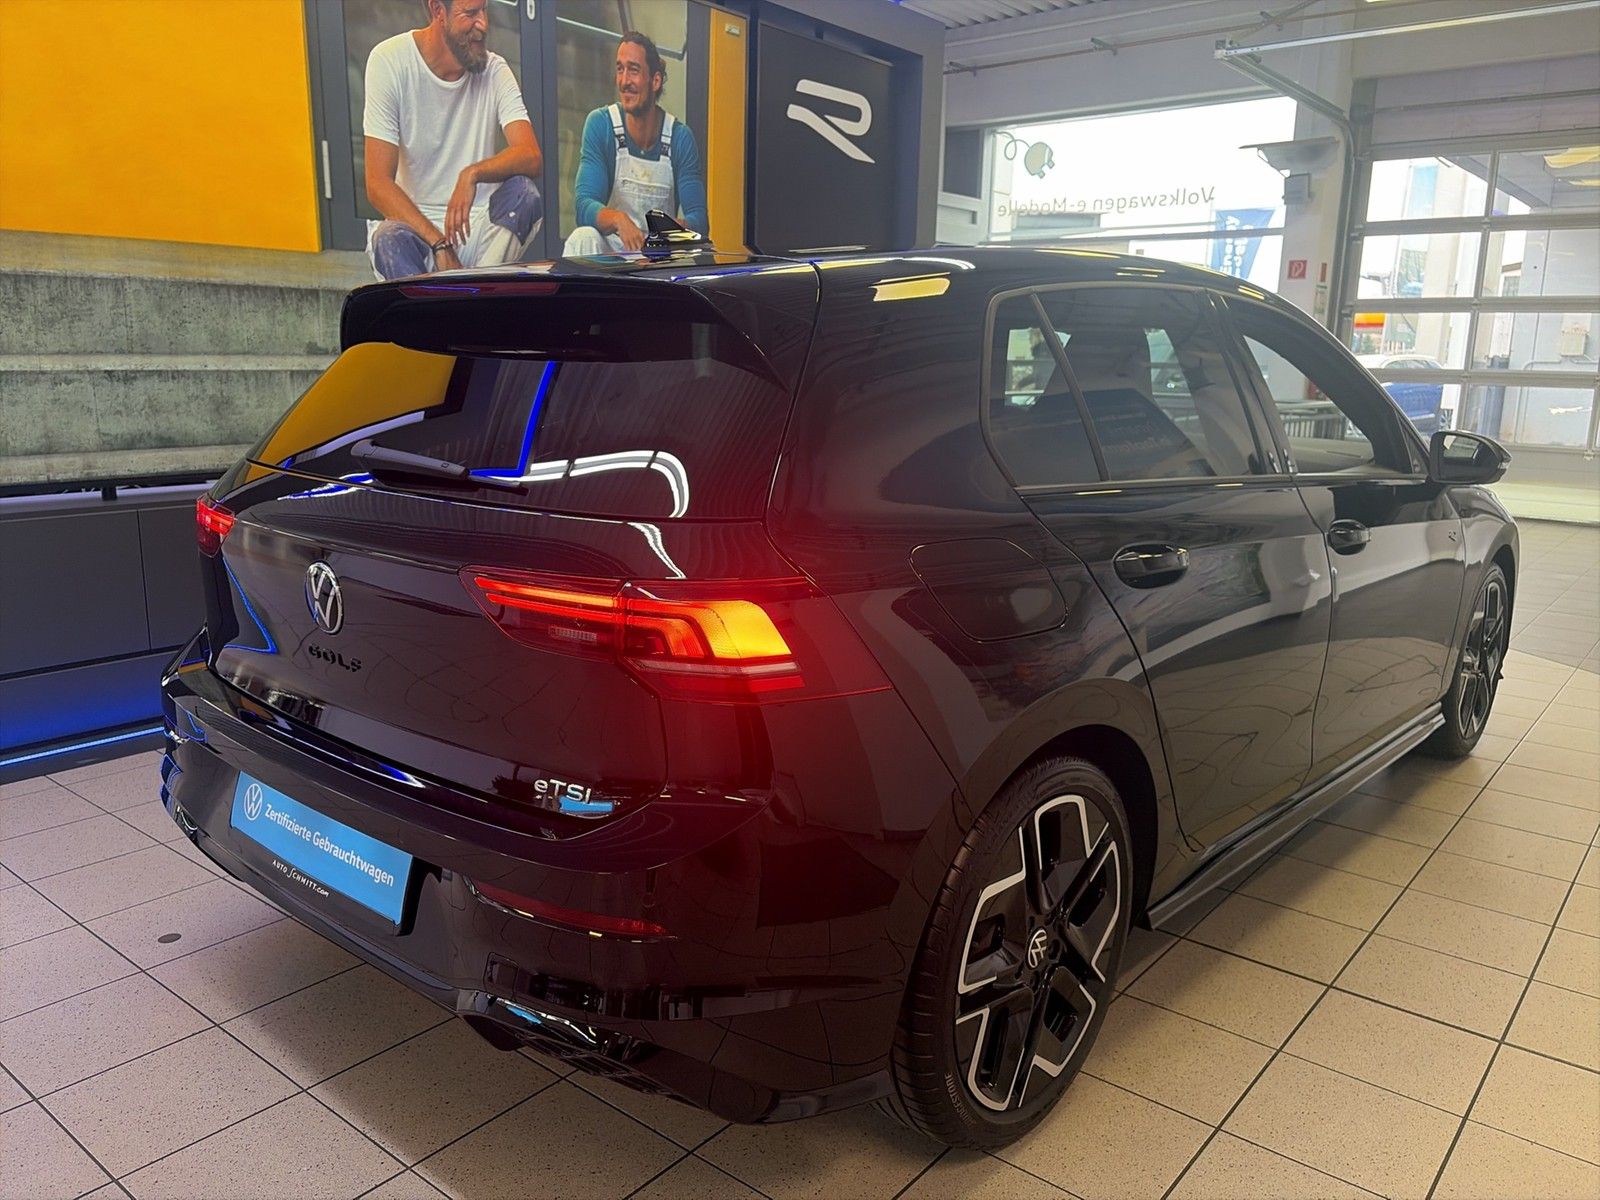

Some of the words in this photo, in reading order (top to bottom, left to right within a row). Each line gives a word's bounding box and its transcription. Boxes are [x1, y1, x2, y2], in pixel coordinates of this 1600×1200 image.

[787, 79, 875, 164] R
[308, 644, 361, 672] GOLF
[534, 779, 592, 804] eTSI
[264, 803, 311, 841] Zertifizierte
[312, 831, 394, 887] Gebrauchtwagen
[272, 860, 287, 873] AUTO
